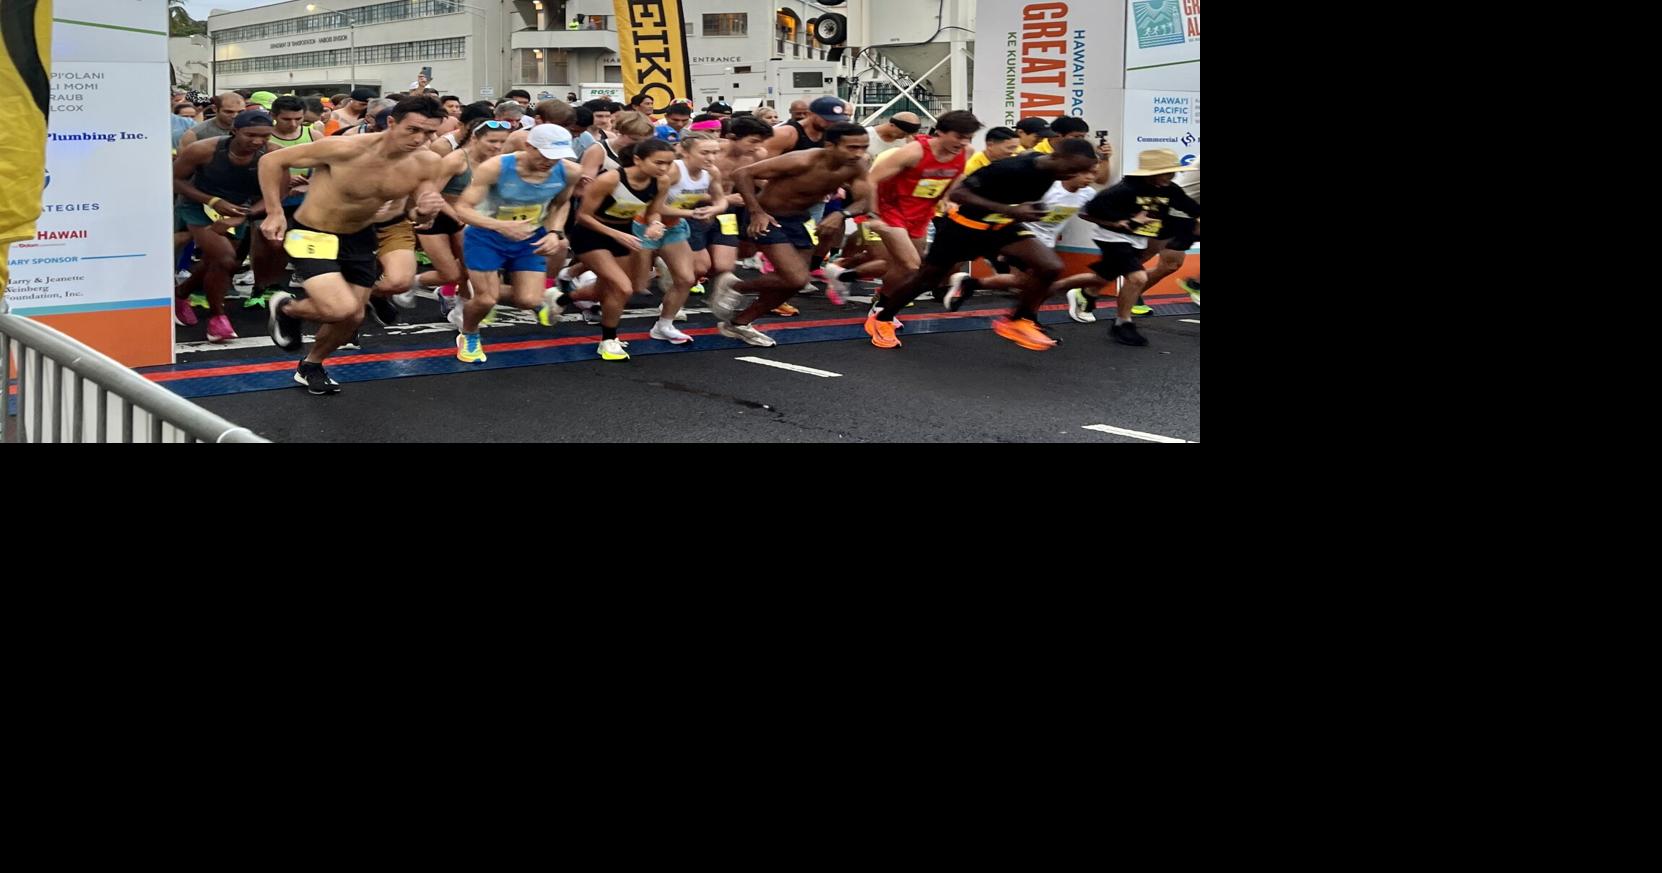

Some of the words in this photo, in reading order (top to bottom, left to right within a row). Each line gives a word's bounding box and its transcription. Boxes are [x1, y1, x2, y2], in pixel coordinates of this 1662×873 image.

[1007, 32, 1017, 47] KE
[1021, 2, 1068, 87] GREAT
[627, 0, 675, 114] EIKO
[64, 83, 98, 91] MOMI
[1153, 106, 1188, 115] PACIFIC
[1153, 115, 1188, 124] HEALTH
[120, 131, 148, 140] Inc.
[37, 230, 88, 241] HAWAII
[32, 256, 79, 265] SPONSOR
[45, 276, 86, 284] Jeanette
